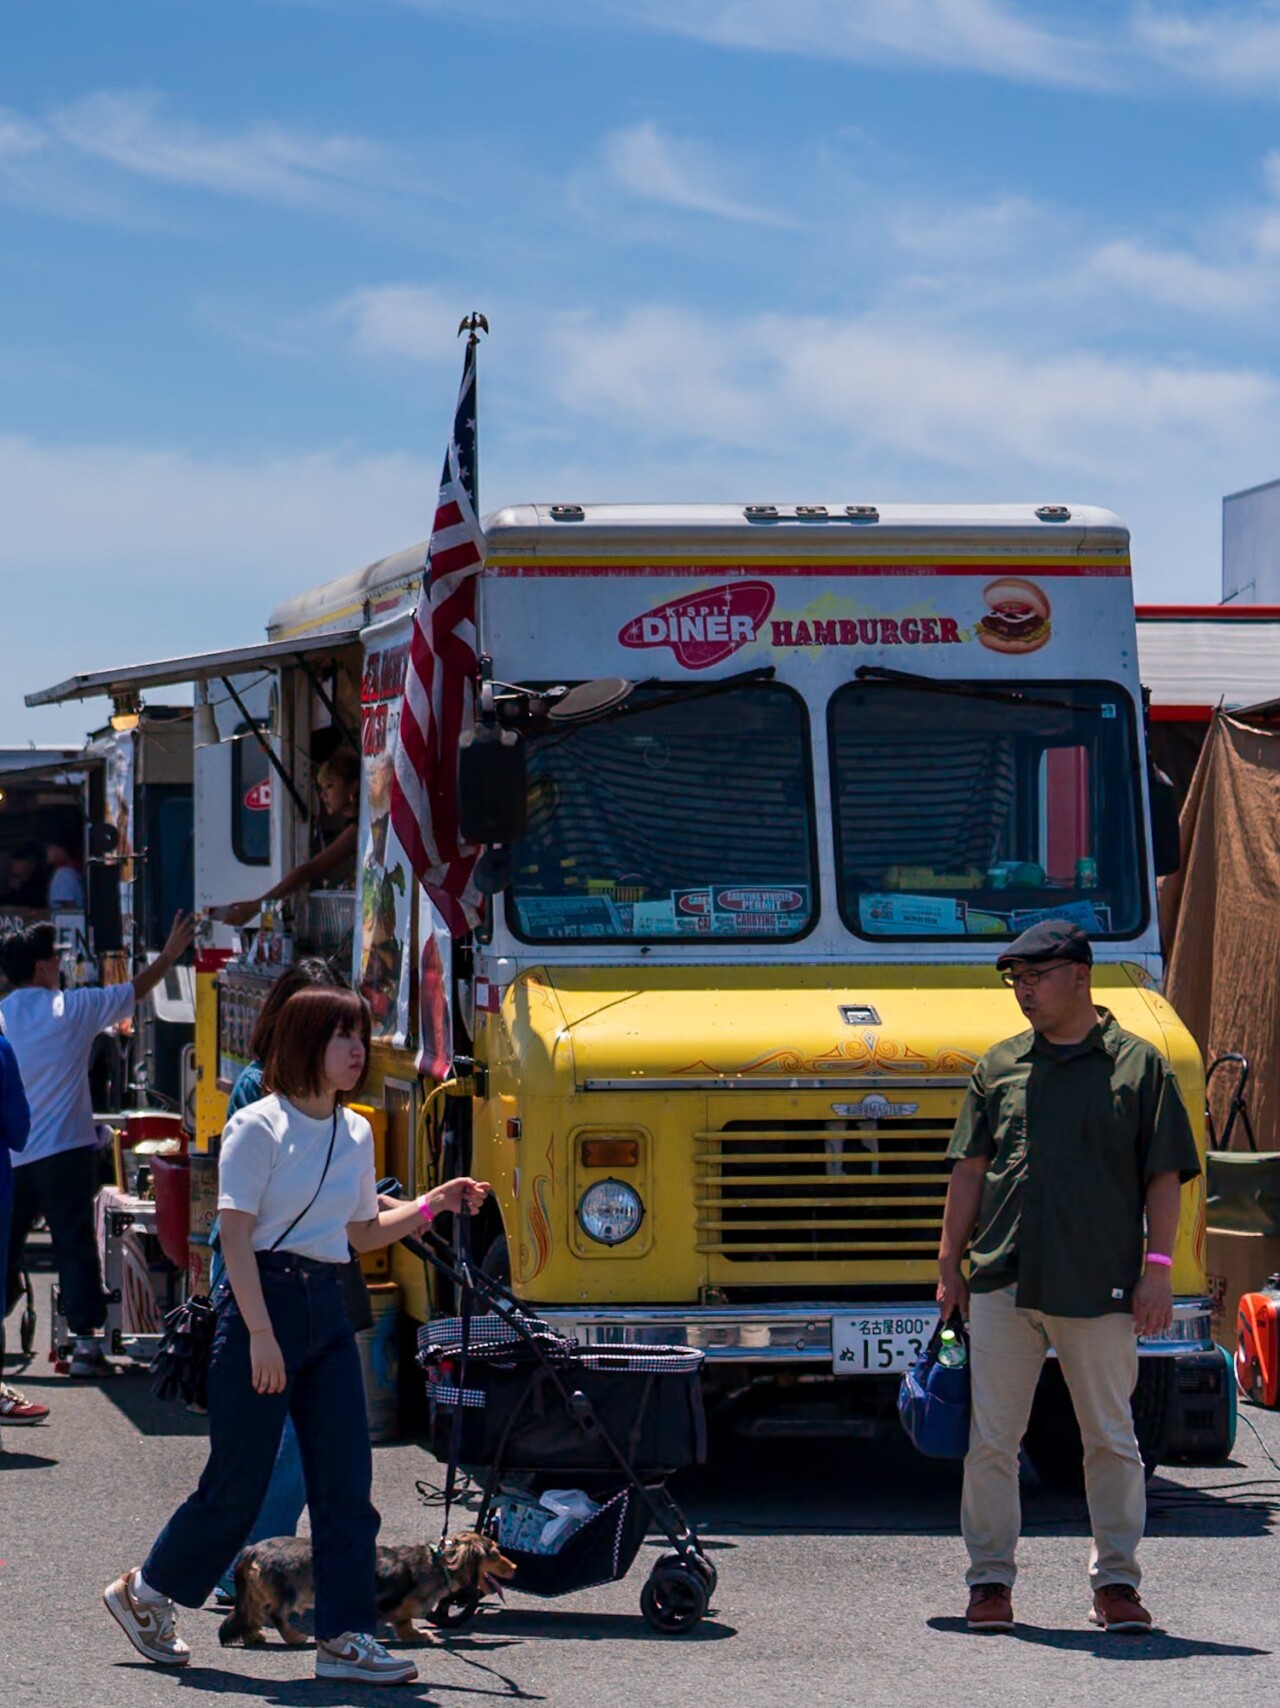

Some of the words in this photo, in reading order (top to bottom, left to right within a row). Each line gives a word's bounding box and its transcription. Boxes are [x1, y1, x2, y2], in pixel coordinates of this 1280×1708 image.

[642, 616, 755, 642] DINER
[771, 618, 962, 647] HAMBURGER
[742, 901, 781, 911] PERMIT
[840, 1347, 854, 1361] ぬ
